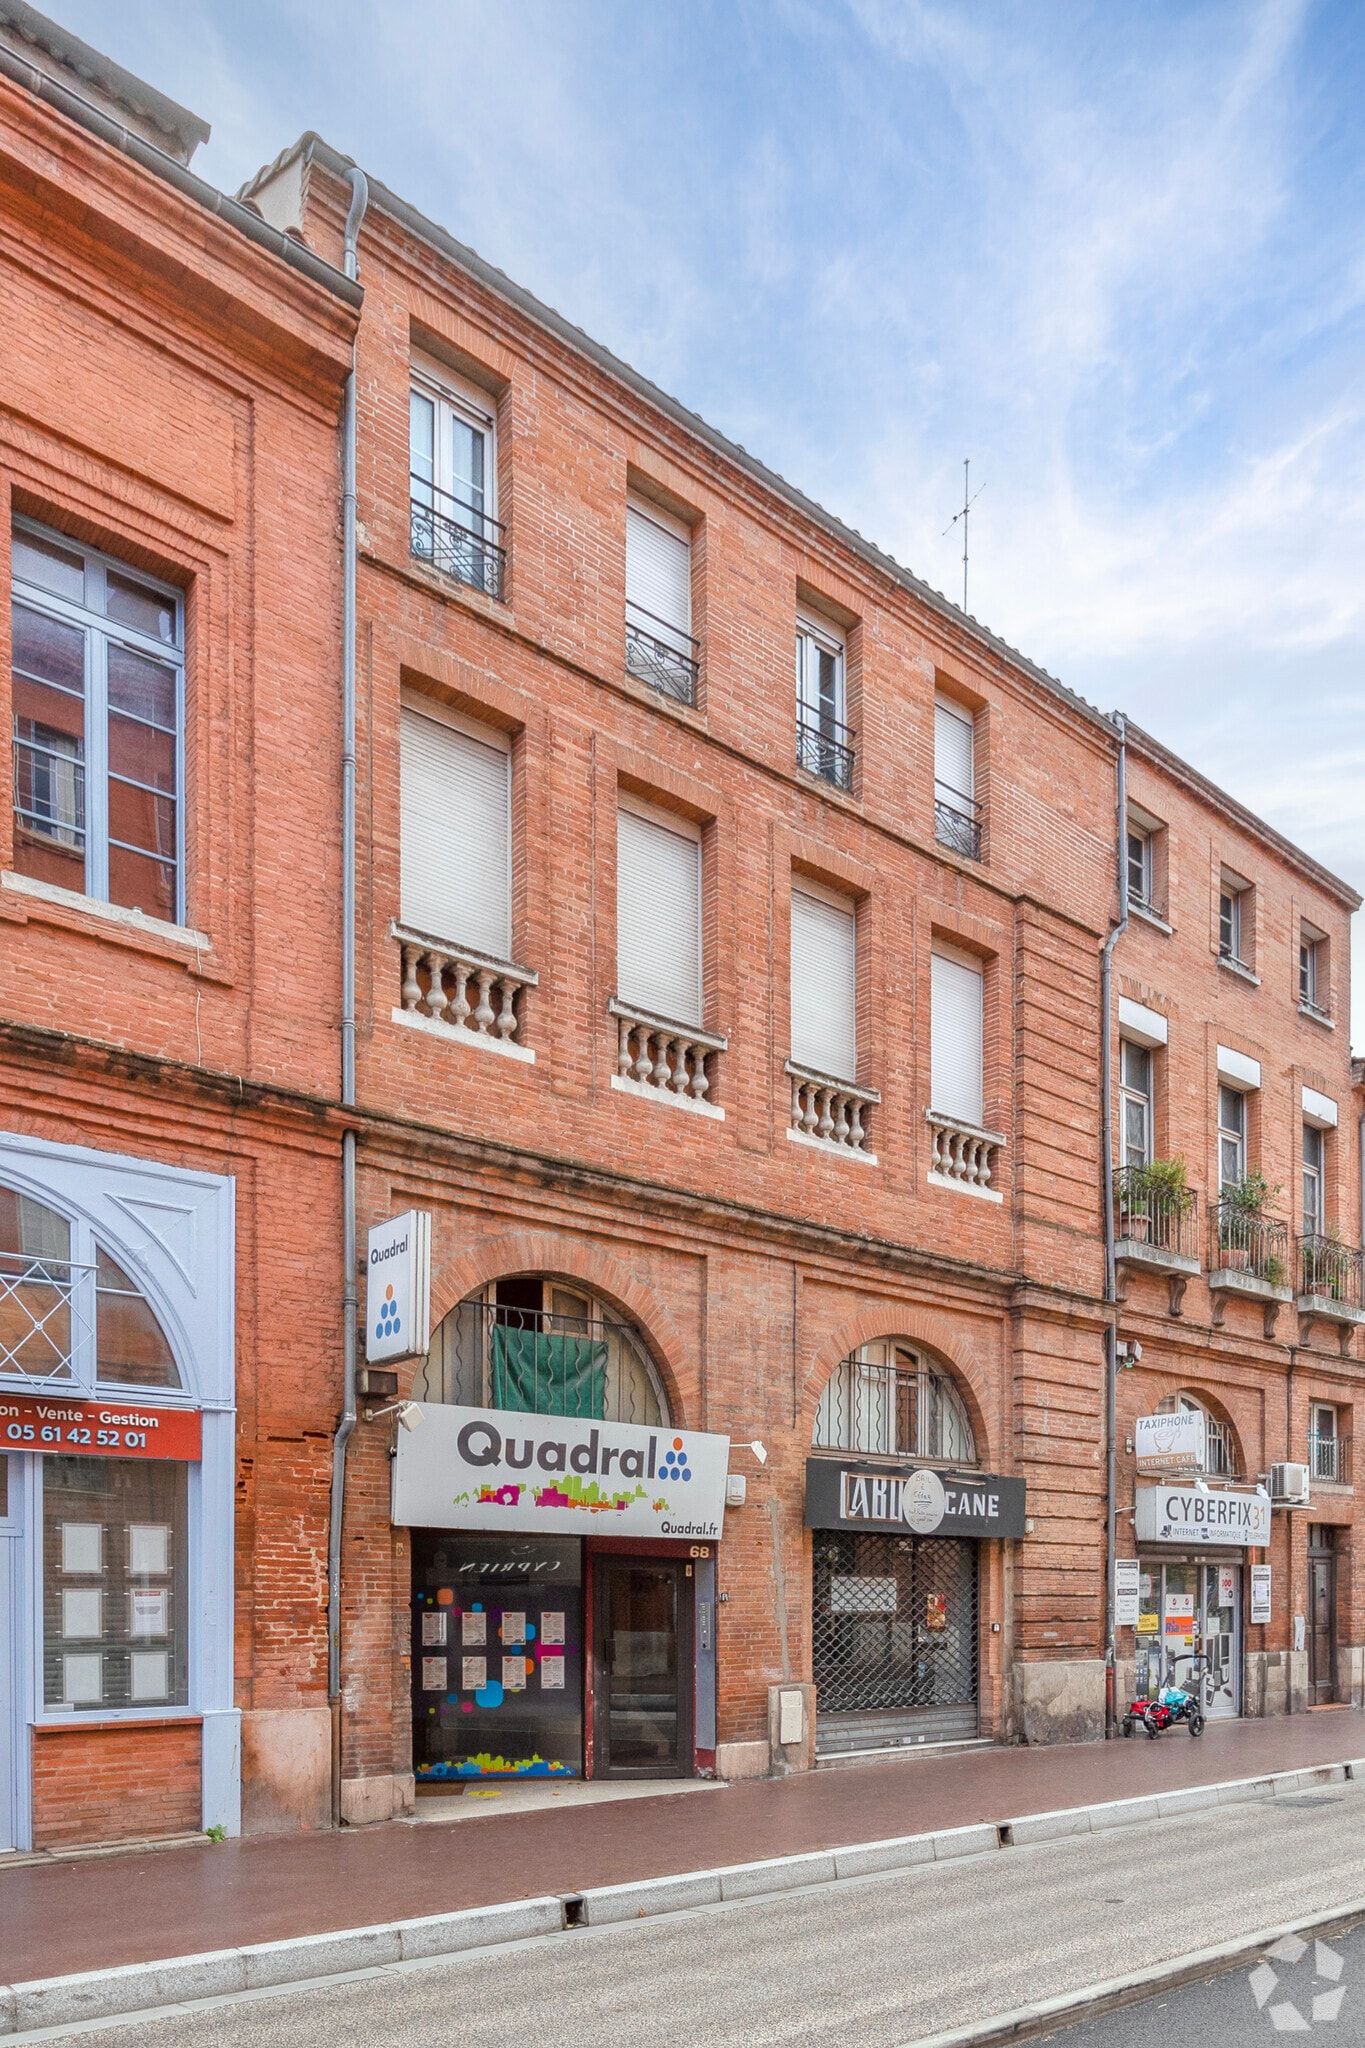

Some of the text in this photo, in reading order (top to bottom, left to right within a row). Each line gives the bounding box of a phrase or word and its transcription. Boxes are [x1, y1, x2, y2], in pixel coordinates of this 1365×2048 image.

[371, 1234, 408, 1265] Quadral
[36, 1406, 83, 1421] Vente
[99, 1411, 159, 1428] Gestion
[1139, 1415, 1194, 1430] TAXIPHONE
[7, 1423, 146, 1448] 05 61 42 52 01
[457, 1420, 658, 1479] Quadral
[1139, 1456, 1174, 1466] INTERNET
[661, 1521, 718, 1535] Quadral.fr
[1172, 1527, 1199, 1537] INTERNET
[1209, 1529, 1242, 1540] INFORMATIQUE
[690, 1546, 709, 1558] 68
